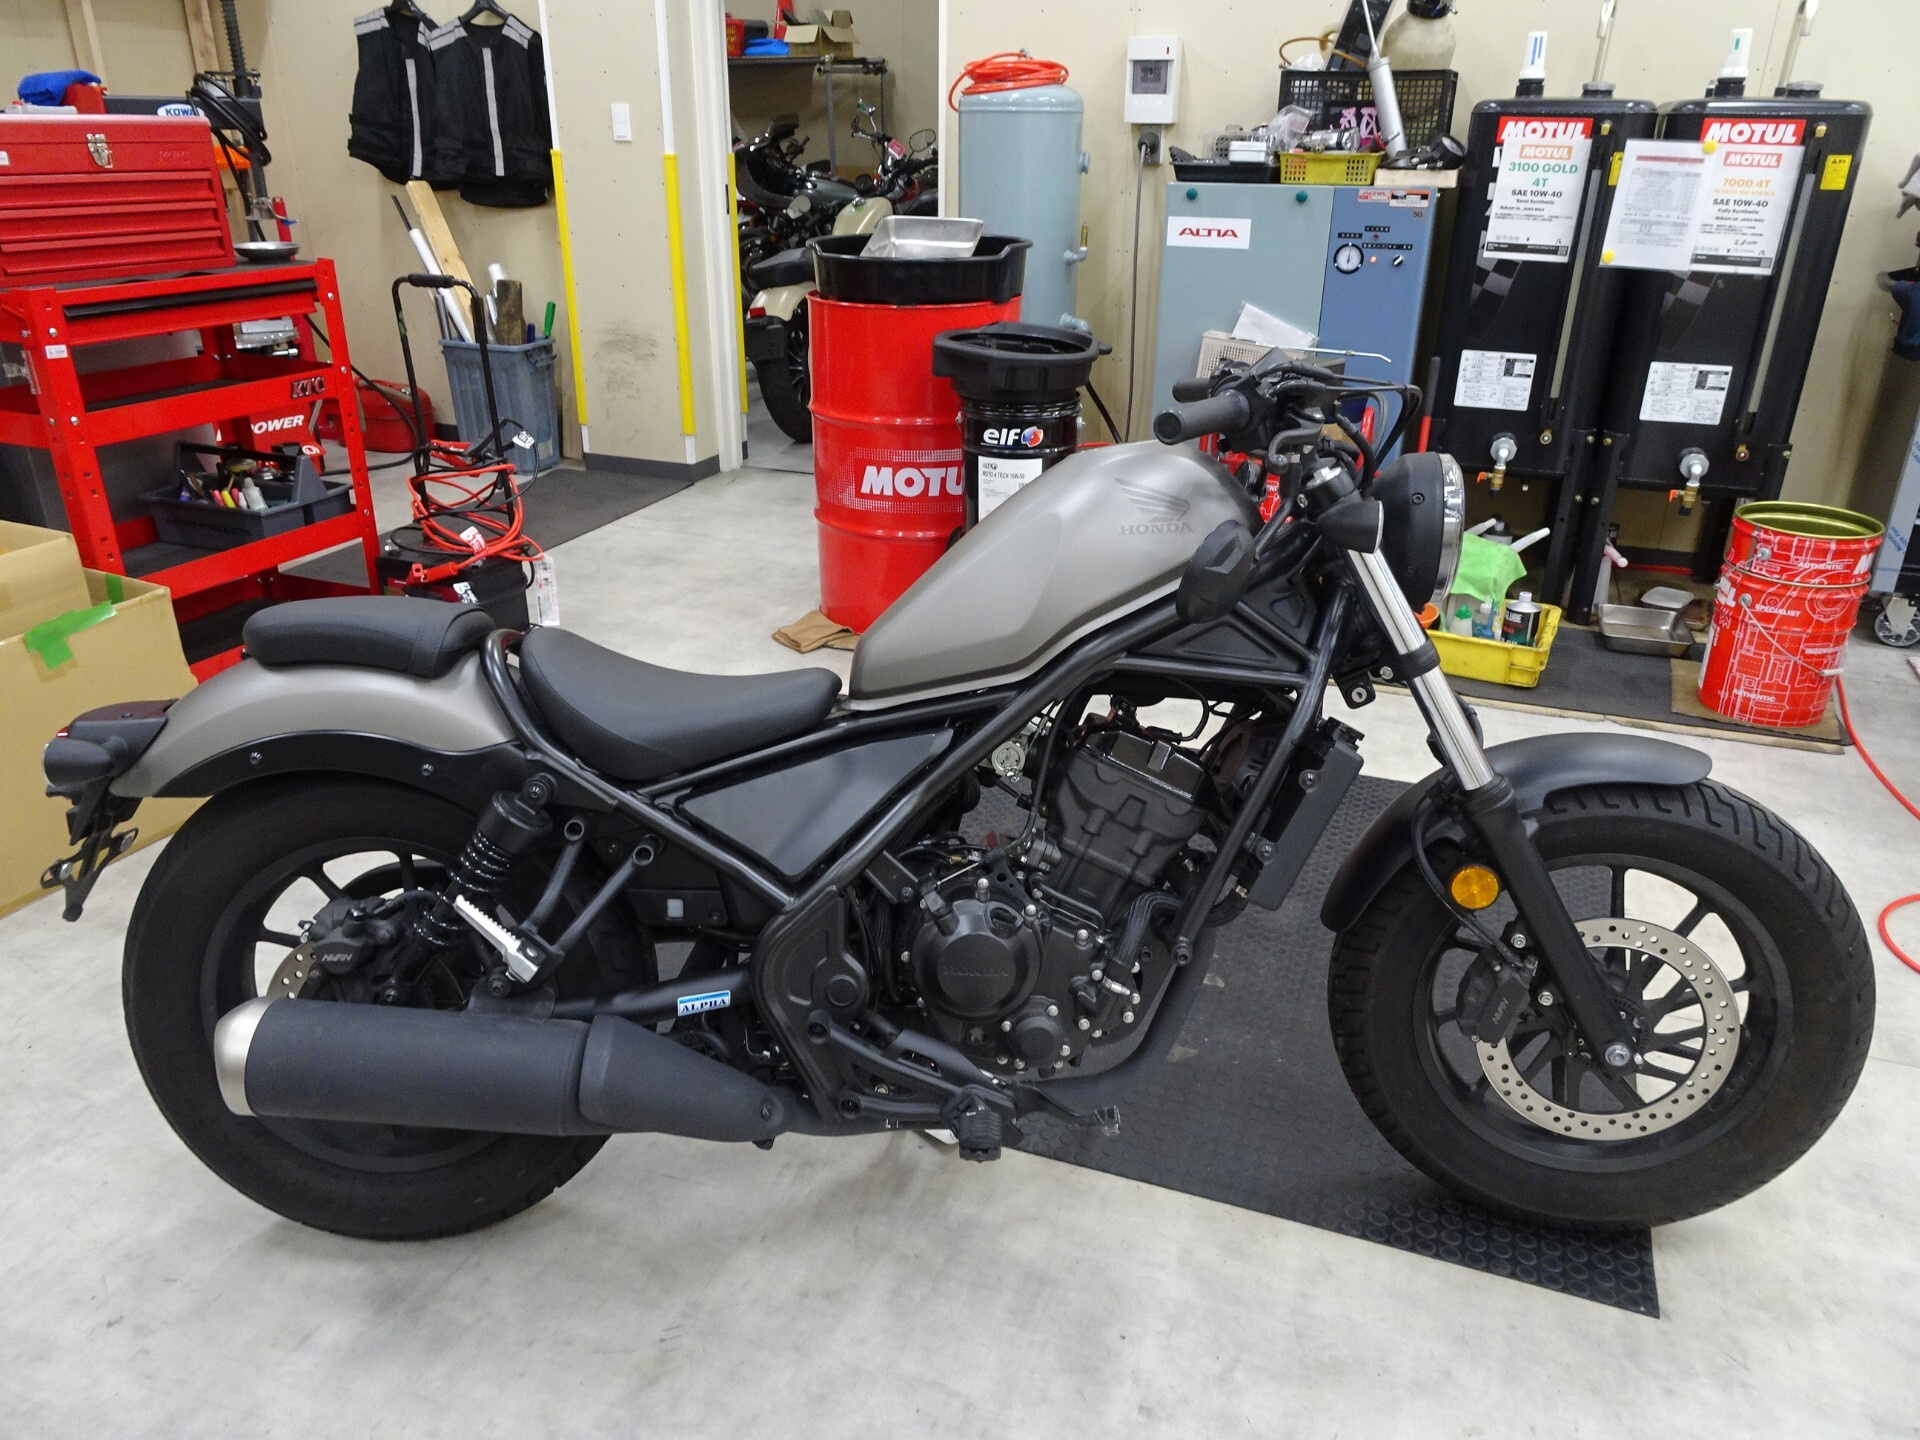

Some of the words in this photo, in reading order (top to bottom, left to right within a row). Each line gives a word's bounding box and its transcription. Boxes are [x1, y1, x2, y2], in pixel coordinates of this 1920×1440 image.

[1500, 121, 1587, 140] MOTUL
[1703, 122, 1798, 144] MOTUL
[1521, 146, 1569, 159] MOTUL
[1726, 153, 1779, 167] MOTUL
[1508, 161, 1540, 173] 3100
[1542, 163, 1579, 174] GOLD
[1532, 177, 1549, 188] 4T
[1722, 177, 1754, 188] 7000
[1755, 179, 1772, 189] 4T
[1511, 188, 1529, 197] SAE
[1530, 189, 1563, 199] 10W-40
[1712, 198, 1731, 207] SAE
[1732, 199, 1769, 208] 10W-40
[1178, 227, 1239, 238] ALTIA
[291, 376, 325, 399] KTC
[250, 414, 305, 434] OWER
[983, 428, 1021, 446] elf
[860, 465, 965, 498] MOTU
[1120, 522, 1194, 536] HONDA
[1797, 561, 1845, 571] AUTHENTIC
[1754, 603, 1801, 617] SPECIALIST
[681, 998, 726, 1013] ALPHA
